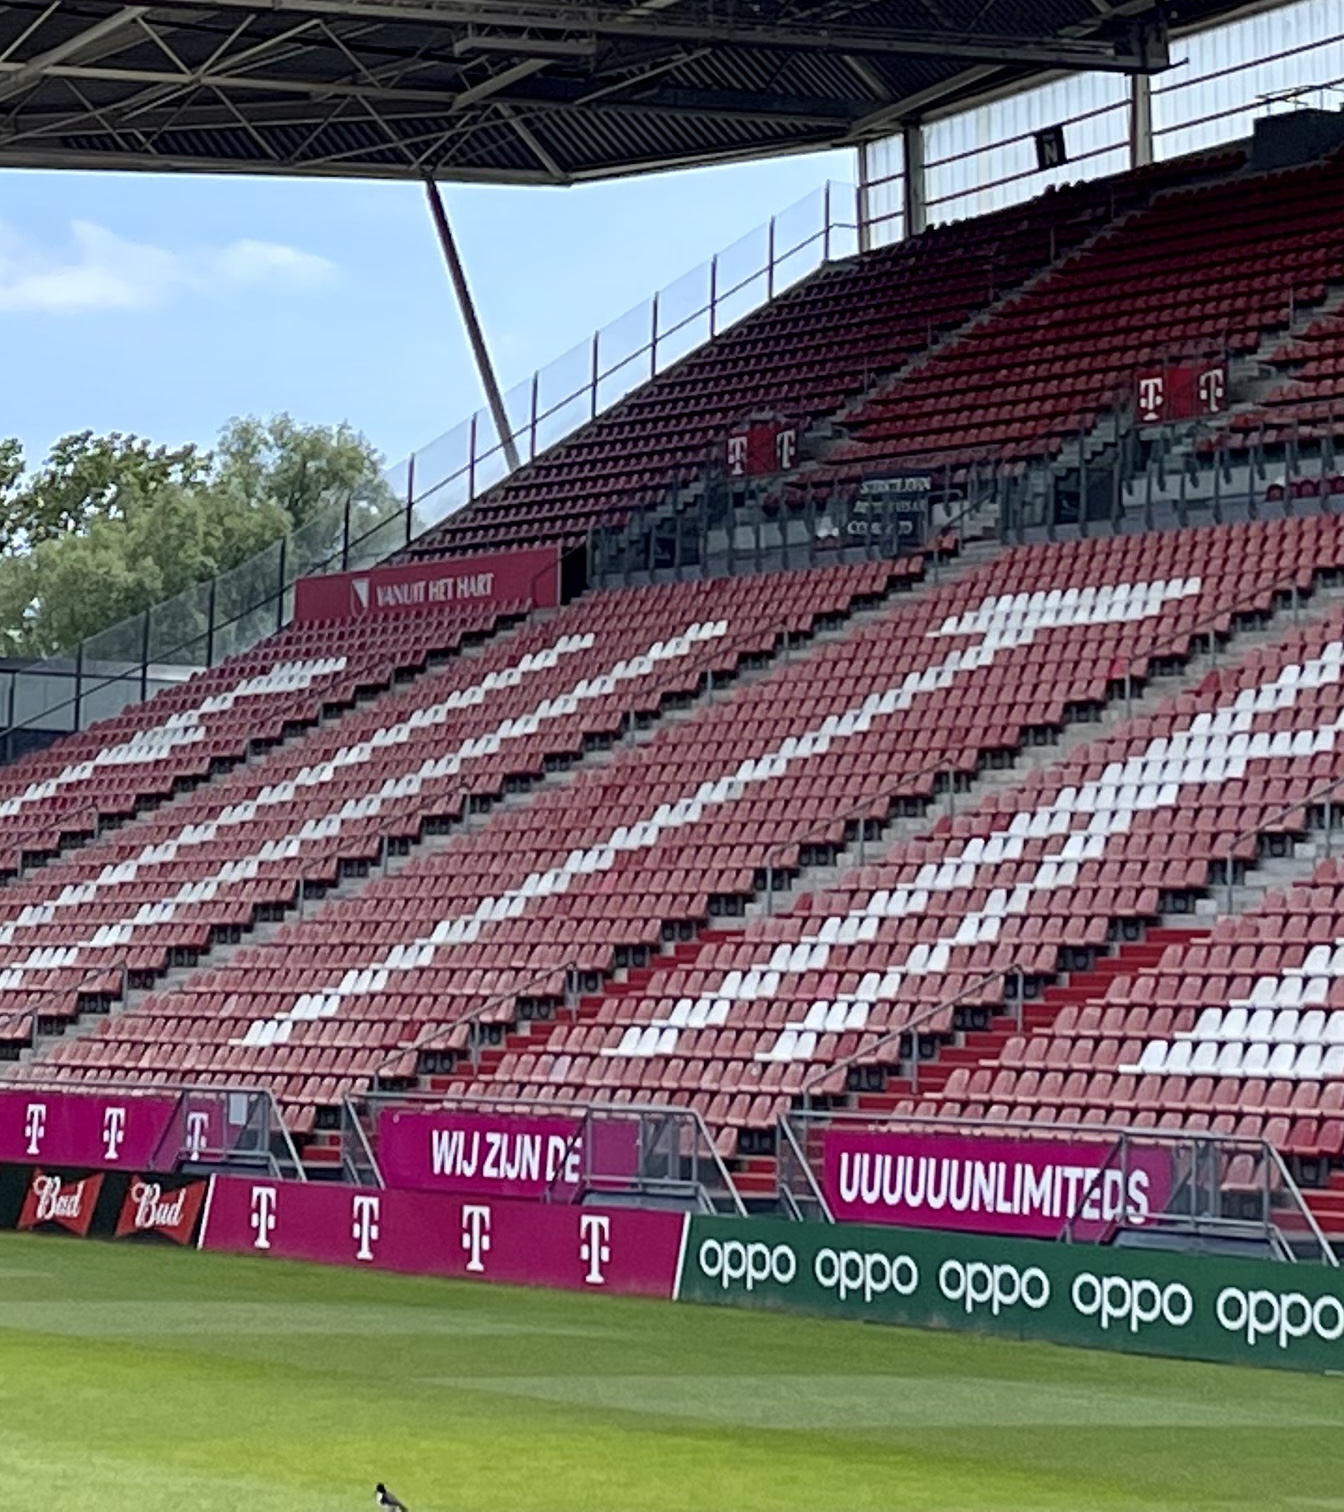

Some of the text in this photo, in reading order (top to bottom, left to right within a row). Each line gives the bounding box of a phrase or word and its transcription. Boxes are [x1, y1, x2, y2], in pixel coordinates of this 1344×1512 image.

[376, 572, 495, 607] VANUIT HET HART
[432, 1129, 583, 1183] WIJ ZIJN DE
[33, 1175, 85, 1221] Bud
[131, 1181, 185, 1229] Bud
[699, 1238, 797, 1291] oppo
[814, 1248, 919, 1303] oppo
[938, 1259, 1050, 1316] oppo
[1072, 1272, 1193, 1333] oppo
